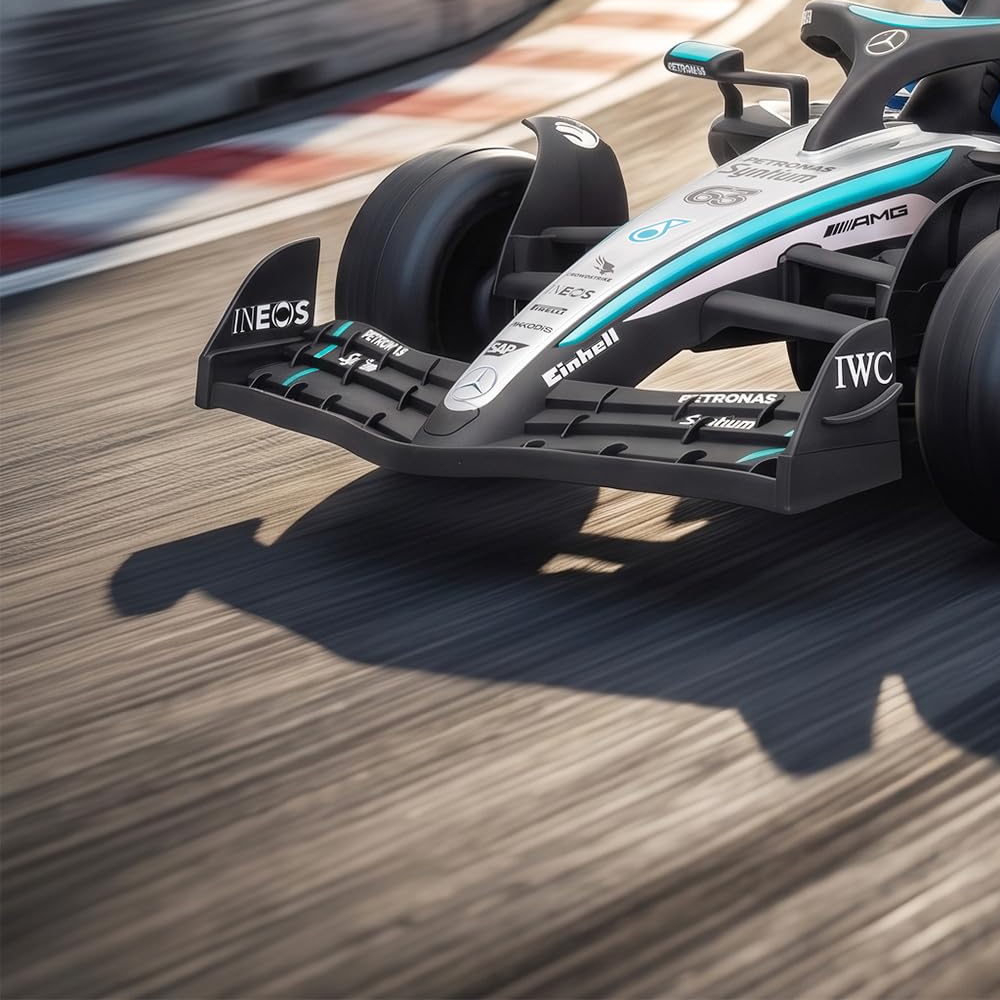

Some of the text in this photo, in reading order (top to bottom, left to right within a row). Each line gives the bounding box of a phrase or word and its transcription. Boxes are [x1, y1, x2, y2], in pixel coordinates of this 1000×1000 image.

[744, 157, 837, 173] PETRONAS
[850, 204, 909, 231] AMG
[232, 300, 310, 335] INEOS
[541, 327, 620, 388] Einhell
[834, 351, 894, 389] IWC
